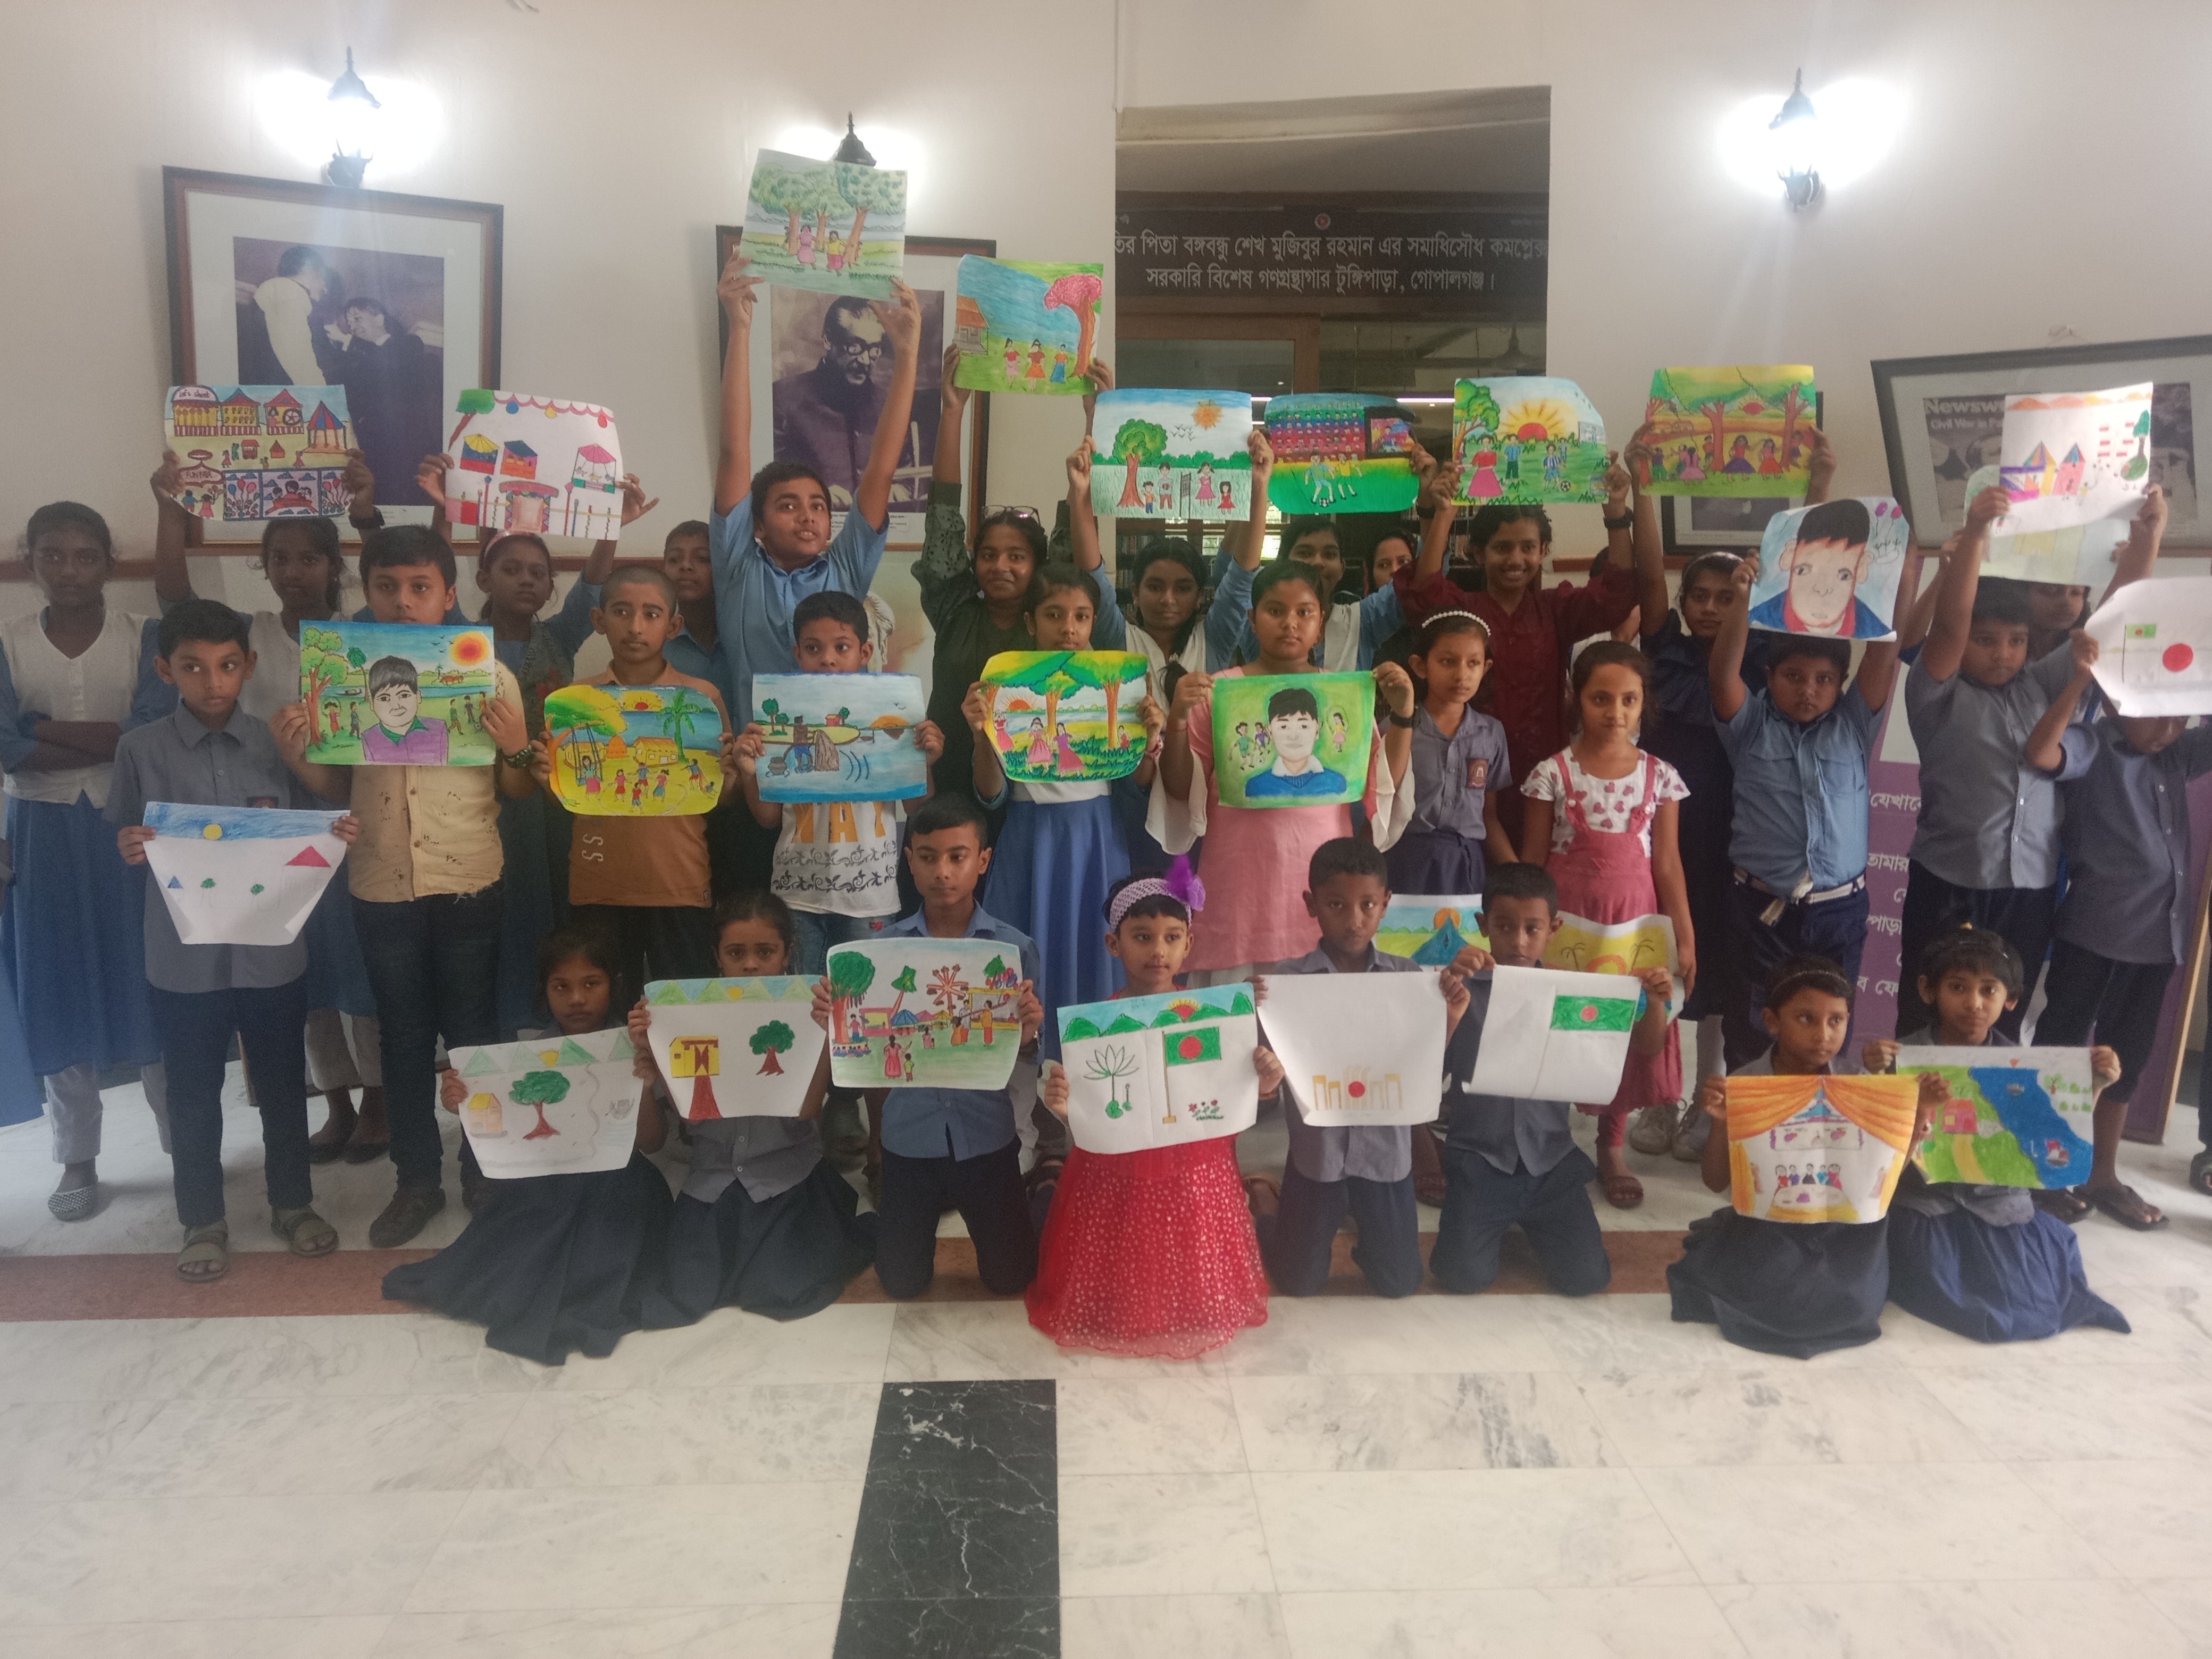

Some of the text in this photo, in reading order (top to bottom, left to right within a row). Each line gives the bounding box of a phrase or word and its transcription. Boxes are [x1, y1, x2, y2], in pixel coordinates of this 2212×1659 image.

[1140, 229, 1178, 255] পিতা
[1182, 236, 1230, 263] বঙ্গবন্ধু
[1235, 234, 1267, 256] শেখ
[1270, 230, 1322, 262] মুজিবুর
[1326, 235, 1375, 257] রহমান
[1379, 237, 1403, 257] এর
[1406, 231, 1486, 258] সমাধিসৌধ
[1145, 262, 1203, 288] সরকারি
[1206, 263, 1254, 289] বিশেষ
[1258, 267, 1332, 293] গণগ্রন্থাগার
